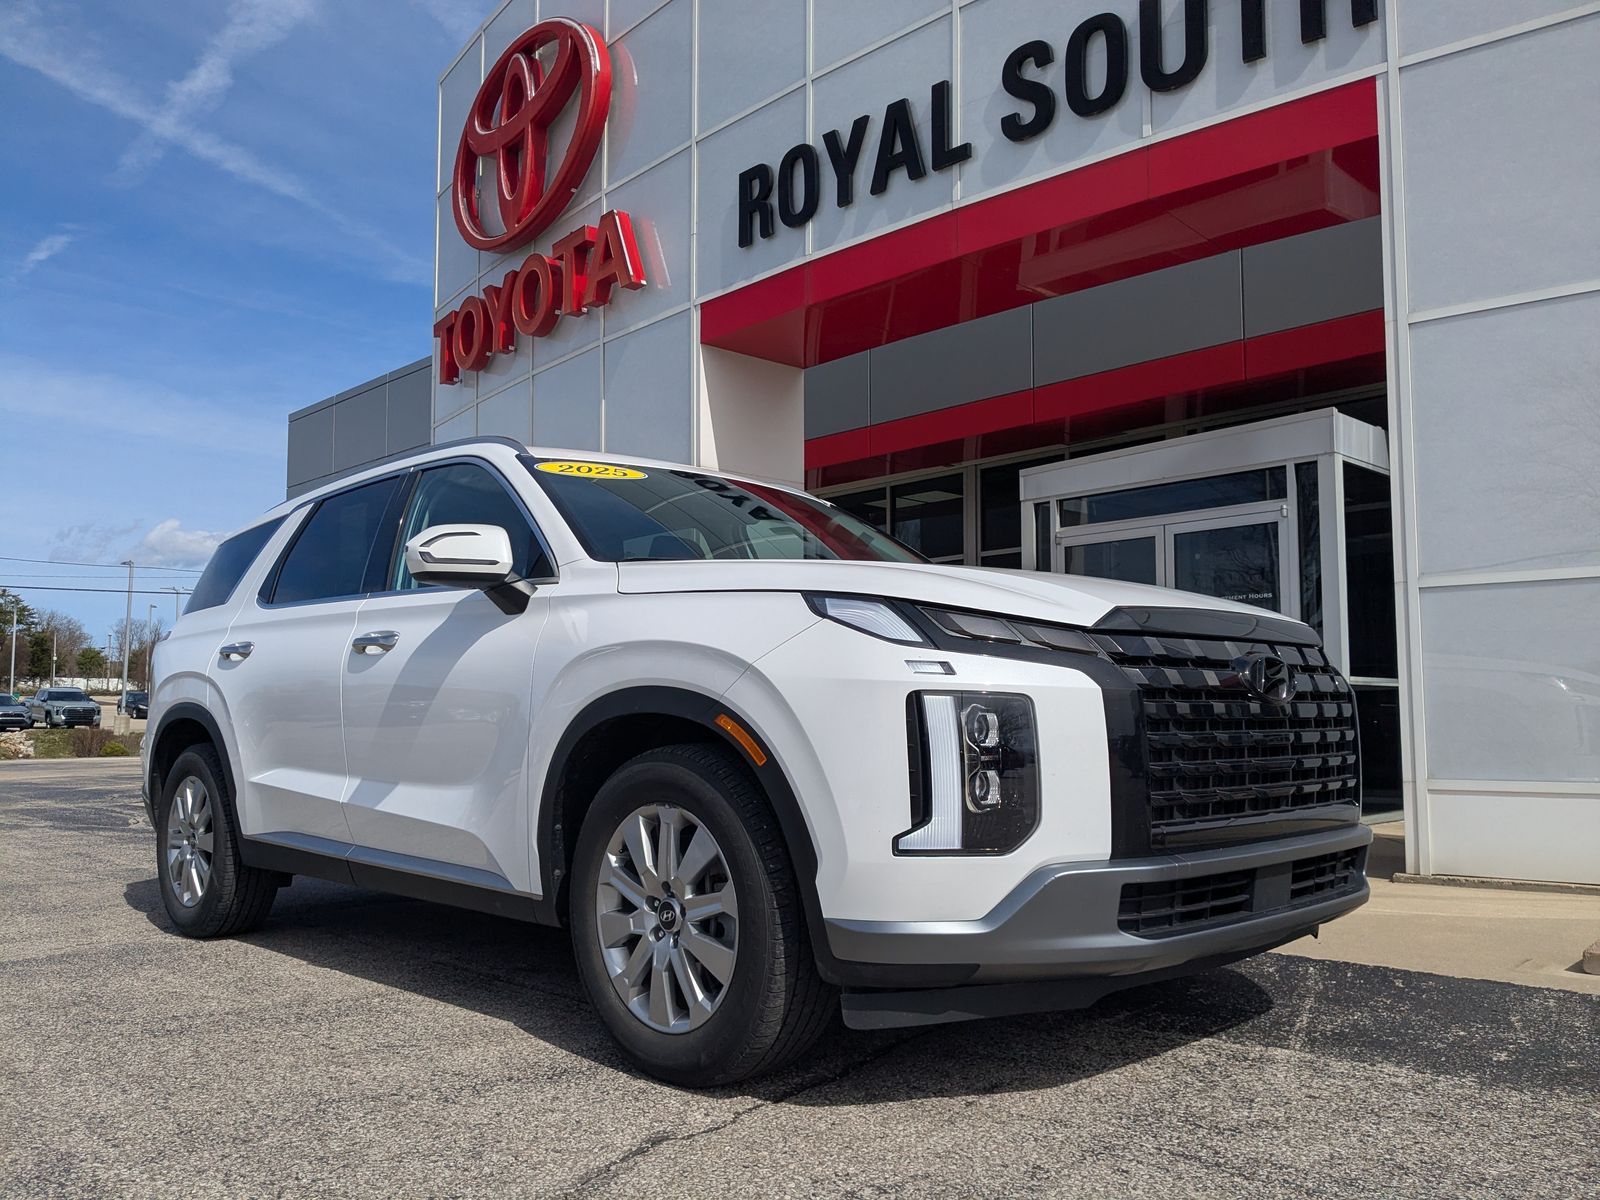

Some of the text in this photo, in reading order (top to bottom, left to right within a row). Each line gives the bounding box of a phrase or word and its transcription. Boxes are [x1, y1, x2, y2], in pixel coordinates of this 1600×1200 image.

[738, 80, 972, 248] ROYAL
[434, 210, 647, 385] TOYOTA
[558, 464, 629, 477] 2025
